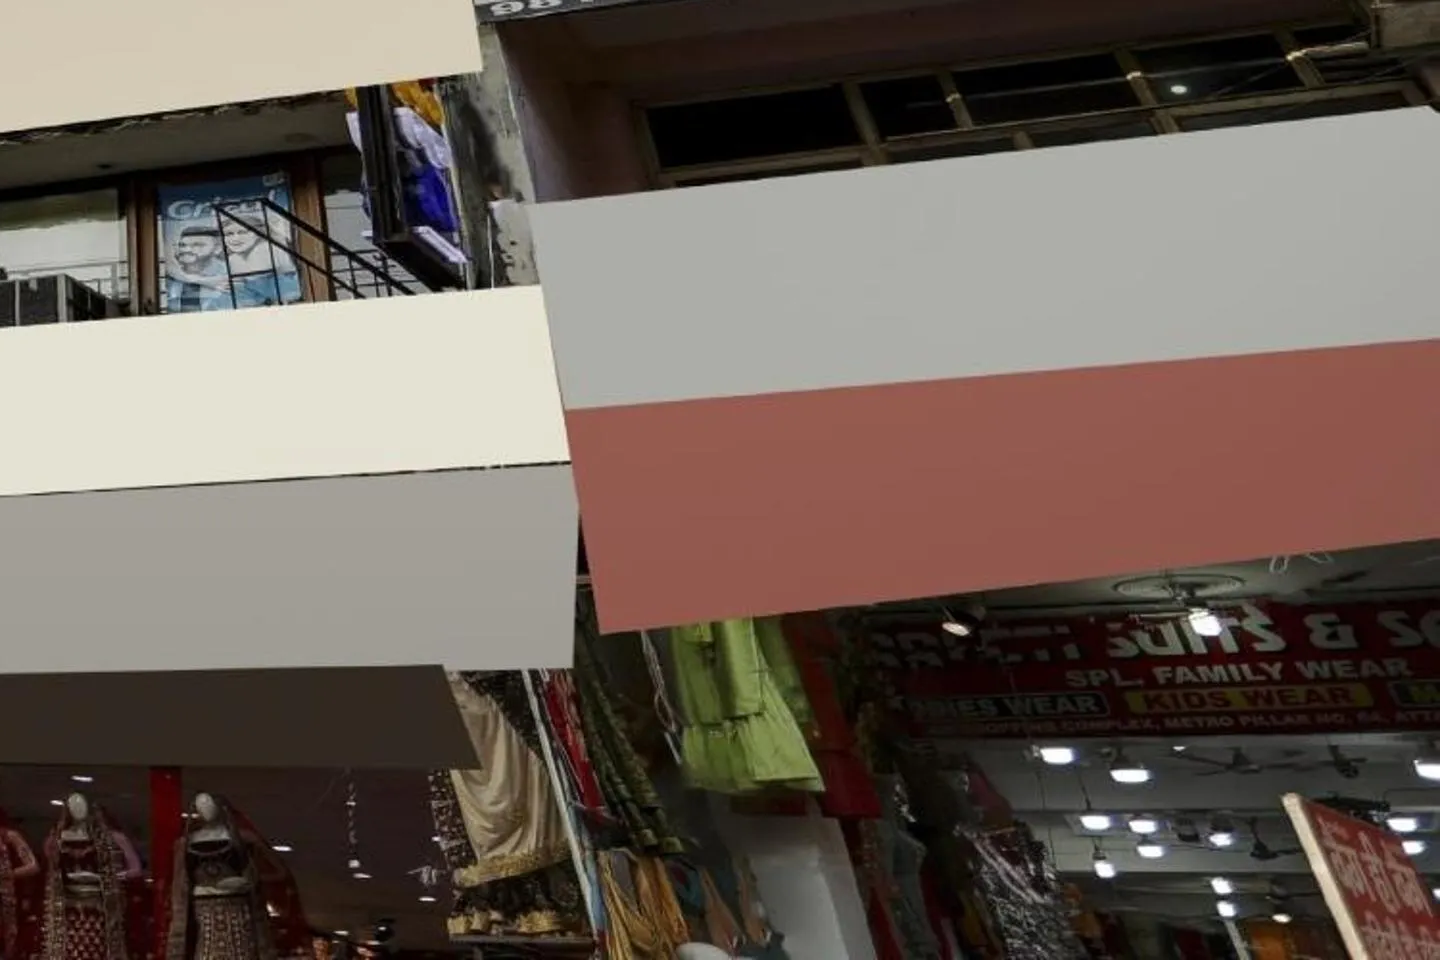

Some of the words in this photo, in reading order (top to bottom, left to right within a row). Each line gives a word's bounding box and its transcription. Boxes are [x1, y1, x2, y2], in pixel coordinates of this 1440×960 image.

[1304, 613, 1358, 649] &
[1153, 662, 1283, 685] FAMILY
[1295, 658, 1414, 680] WEAR
[1003, 693, 1099, 716] WEAR
[1147, 690, 1230, 713] KIDS
[1244, 688, 1353, 709] WEAR
